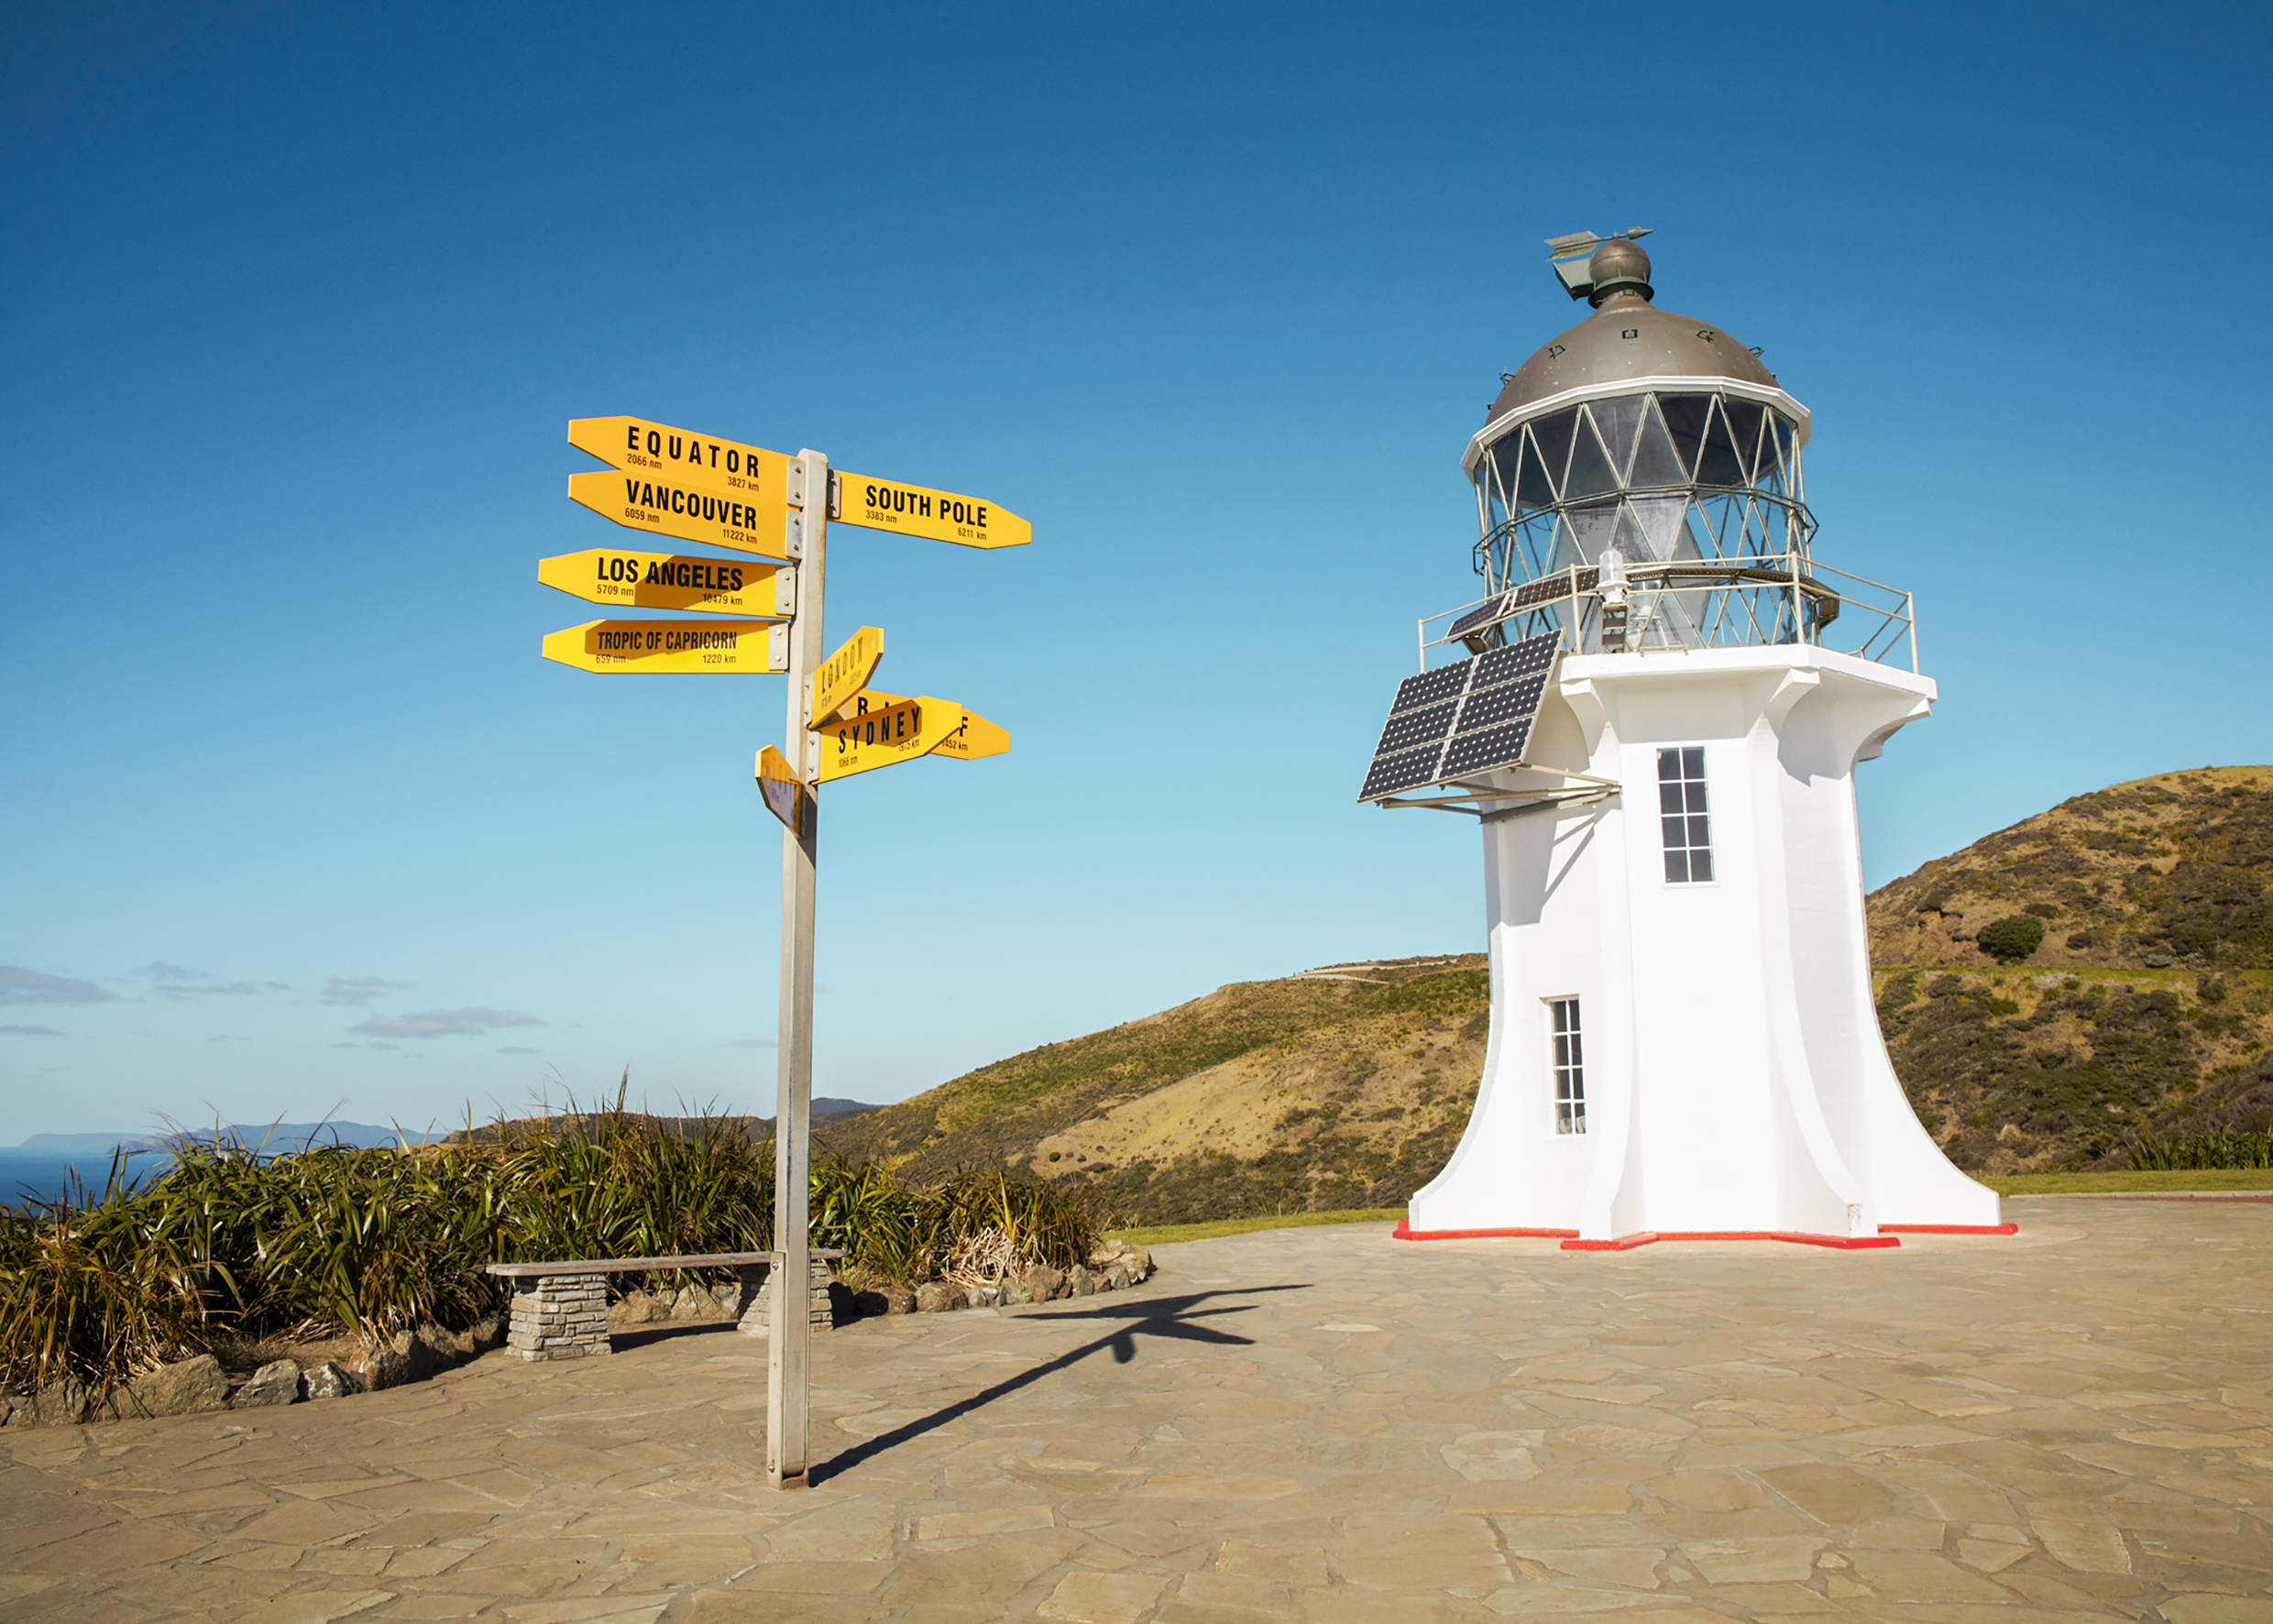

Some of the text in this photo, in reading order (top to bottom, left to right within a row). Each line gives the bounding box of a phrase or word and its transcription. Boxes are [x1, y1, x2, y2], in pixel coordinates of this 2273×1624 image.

[627, 425, 759, 478] EQUATOR
[627, 453, 662, 470] 2066 nm
[727, 476, 759, 491] 3827 km
[626, 478, 757, 531] VANCOUVER
[865, 485, 987, 528] SOUTH POLE
[625, 507, 660, 524] 6059 nm
[865, 510, 897, 523] 3383 nm
[722, 528, 757, 544] 11222 km
[958, 527, 987, 540] 6211 km
[598, 556, 743, 591] LOS ANGELES
[597, 584, 634, 597] 5709 nm
[703, 593, 743, 606] 10479 km
[598, 631, 737, 650] TROPIC OF CAPRICORN
[596, 653, 626, 664] 659 nm
[703, 654, 737, 664] 1220 km
[822, 636, 863, 694] LONDON
[839, 707, 920, 754] SYDNEY
[911, 739, 920, 748] km
[958, 742, 969, 752] km
